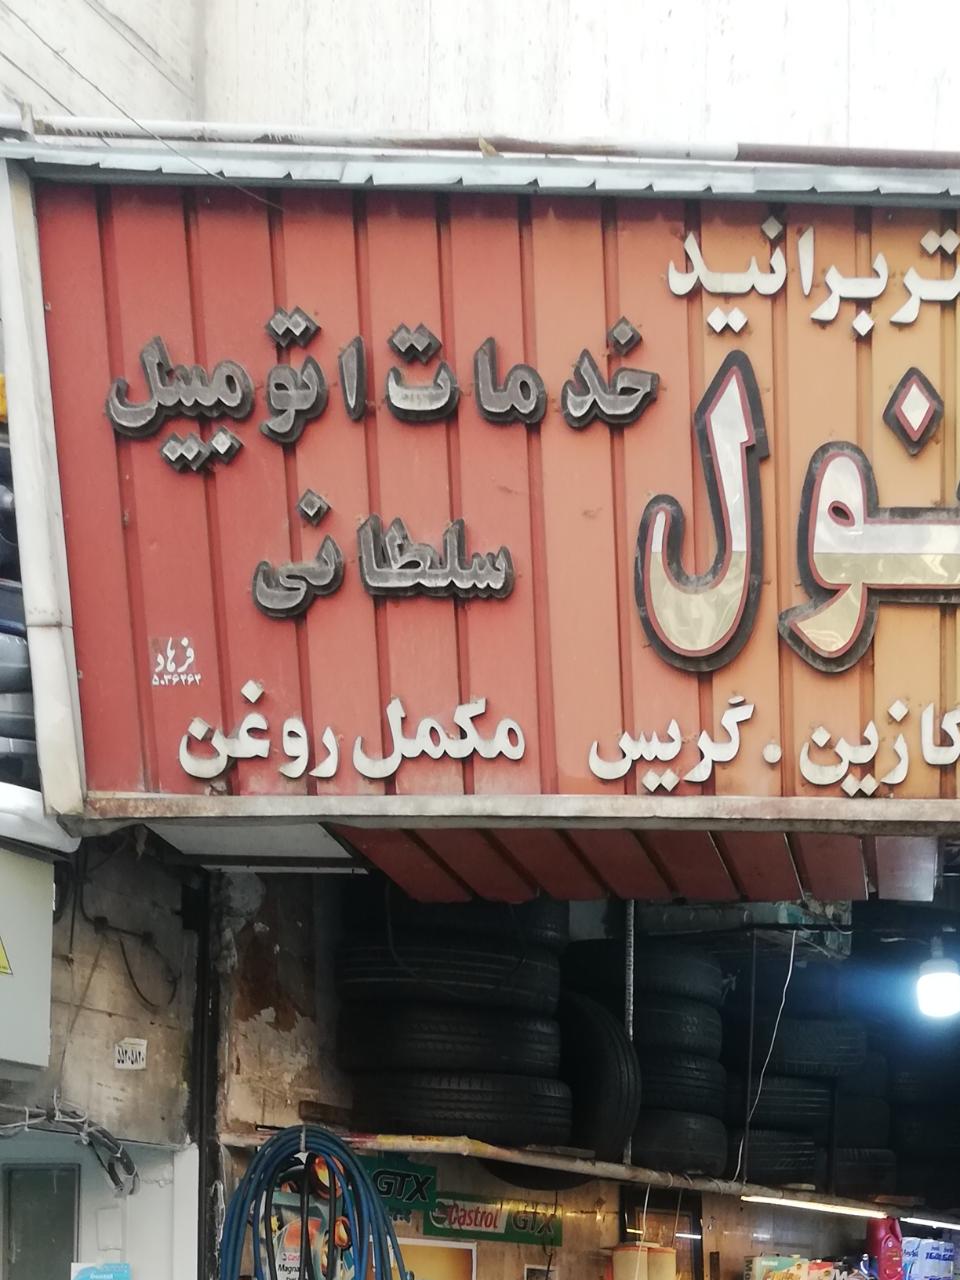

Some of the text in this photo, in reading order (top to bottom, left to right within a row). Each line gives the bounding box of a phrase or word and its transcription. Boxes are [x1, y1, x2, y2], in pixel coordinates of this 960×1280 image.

[667, 215, 890, 337] برانید
[105, 304, 660, 474] خدمات اتومبیل
[251, 488, 516, 624] سلطانی
[154, 636, 195, 673] فرهاد
[178, 679, 341, 780] روغن
[352, 698, 527, 780] مکمل
[587, 695, 756, 794] گریس
[372, 1168, 434, 1203] GTX
[449, 1201, 559, 1237] Castrol GTX
